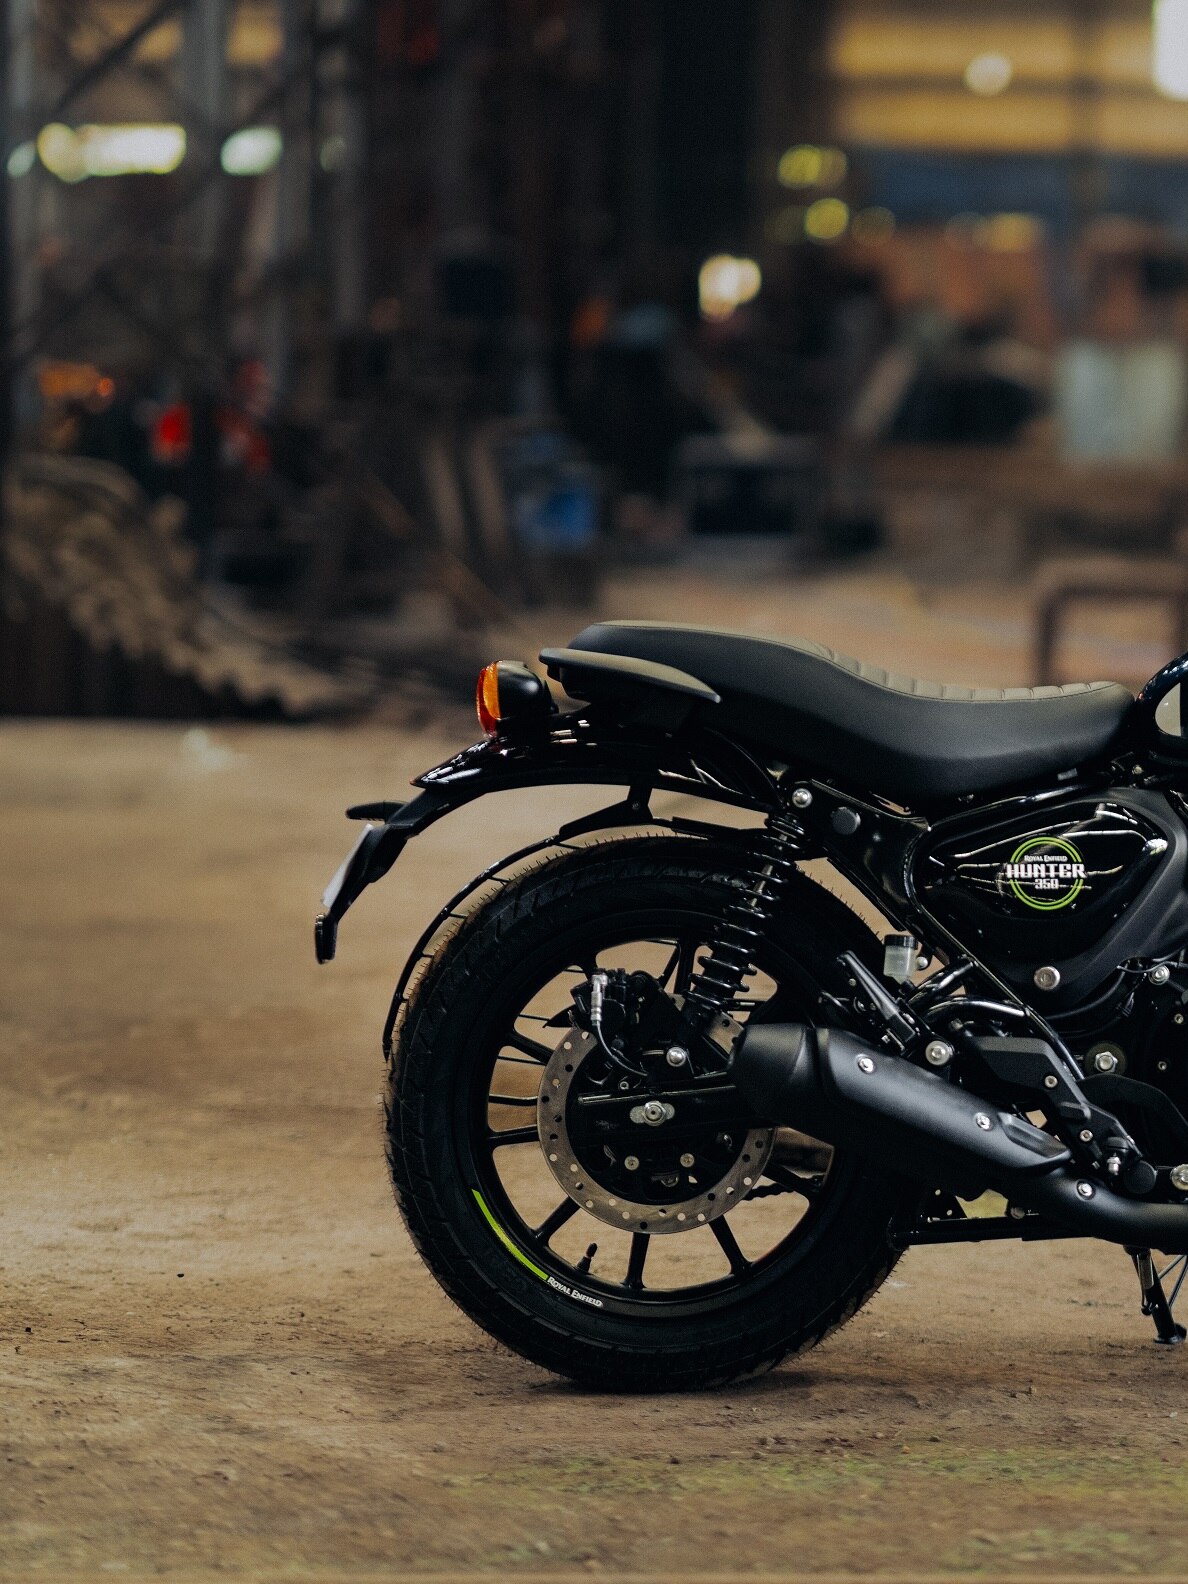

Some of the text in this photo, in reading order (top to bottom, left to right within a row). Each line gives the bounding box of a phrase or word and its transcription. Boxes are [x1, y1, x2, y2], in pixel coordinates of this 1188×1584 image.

[1006, 863, 1087, 879] HUNTER
[1034, 878, 1059, 890] 350
[547, 1276, 603, 1308] ROYAL ENFIELD
